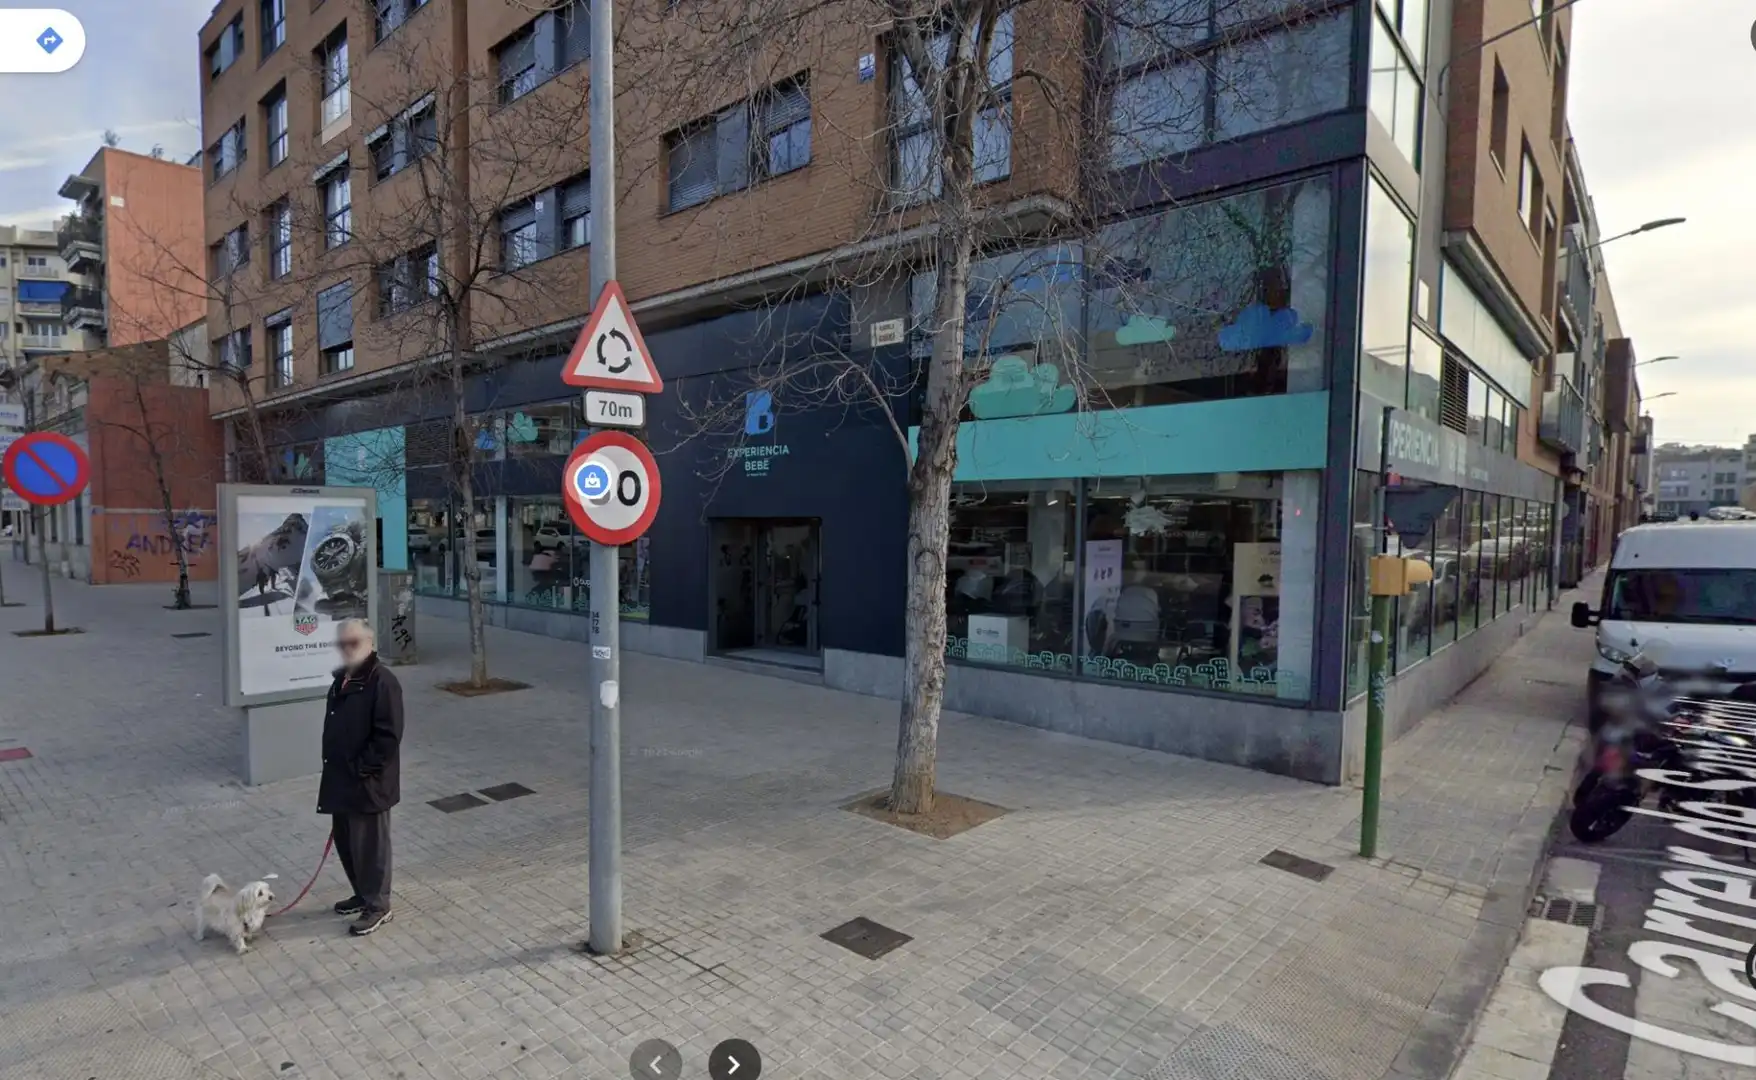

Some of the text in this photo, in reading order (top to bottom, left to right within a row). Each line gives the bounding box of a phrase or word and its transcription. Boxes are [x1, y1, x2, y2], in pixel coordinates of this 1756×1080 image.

[598, 400, 633, 418] 70m
[727, 444, 790, 459] EXPERIENCIA
[297, 616, 316, 625] TAG
[275, 643, 304, 653] BEYOND
[305, 641, 318, 650] THE
